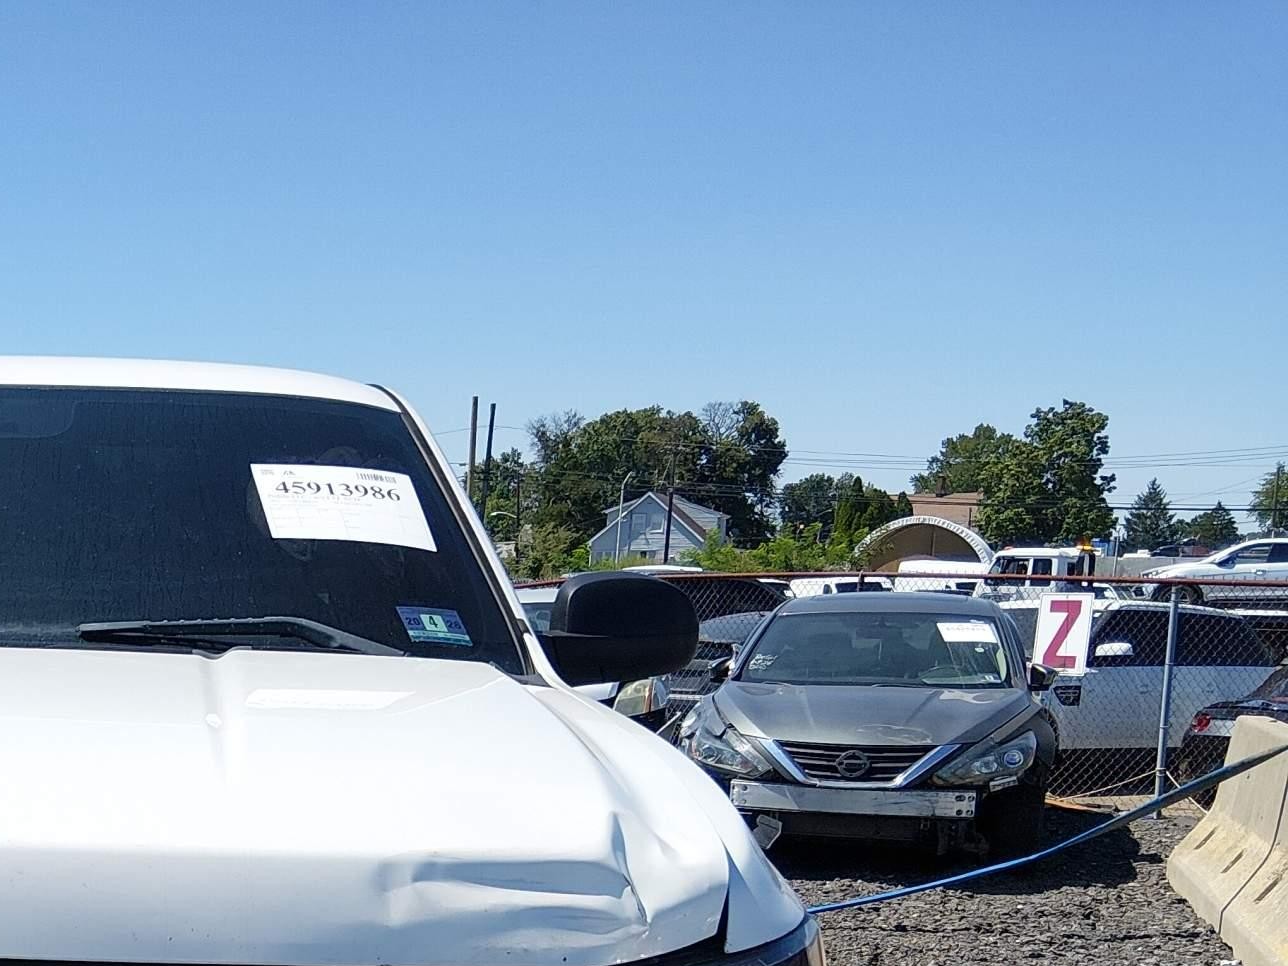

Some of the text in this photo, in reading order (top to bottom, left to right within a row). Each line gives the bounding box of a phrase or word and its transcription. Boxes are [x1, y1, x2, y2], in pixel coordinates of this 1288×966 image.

[275, 480, 401, 501] 45913986
[405, 617, 421, 626] 20
[428, 615, 438, 629] 4
[1042, 599, 1083, 669] Z
